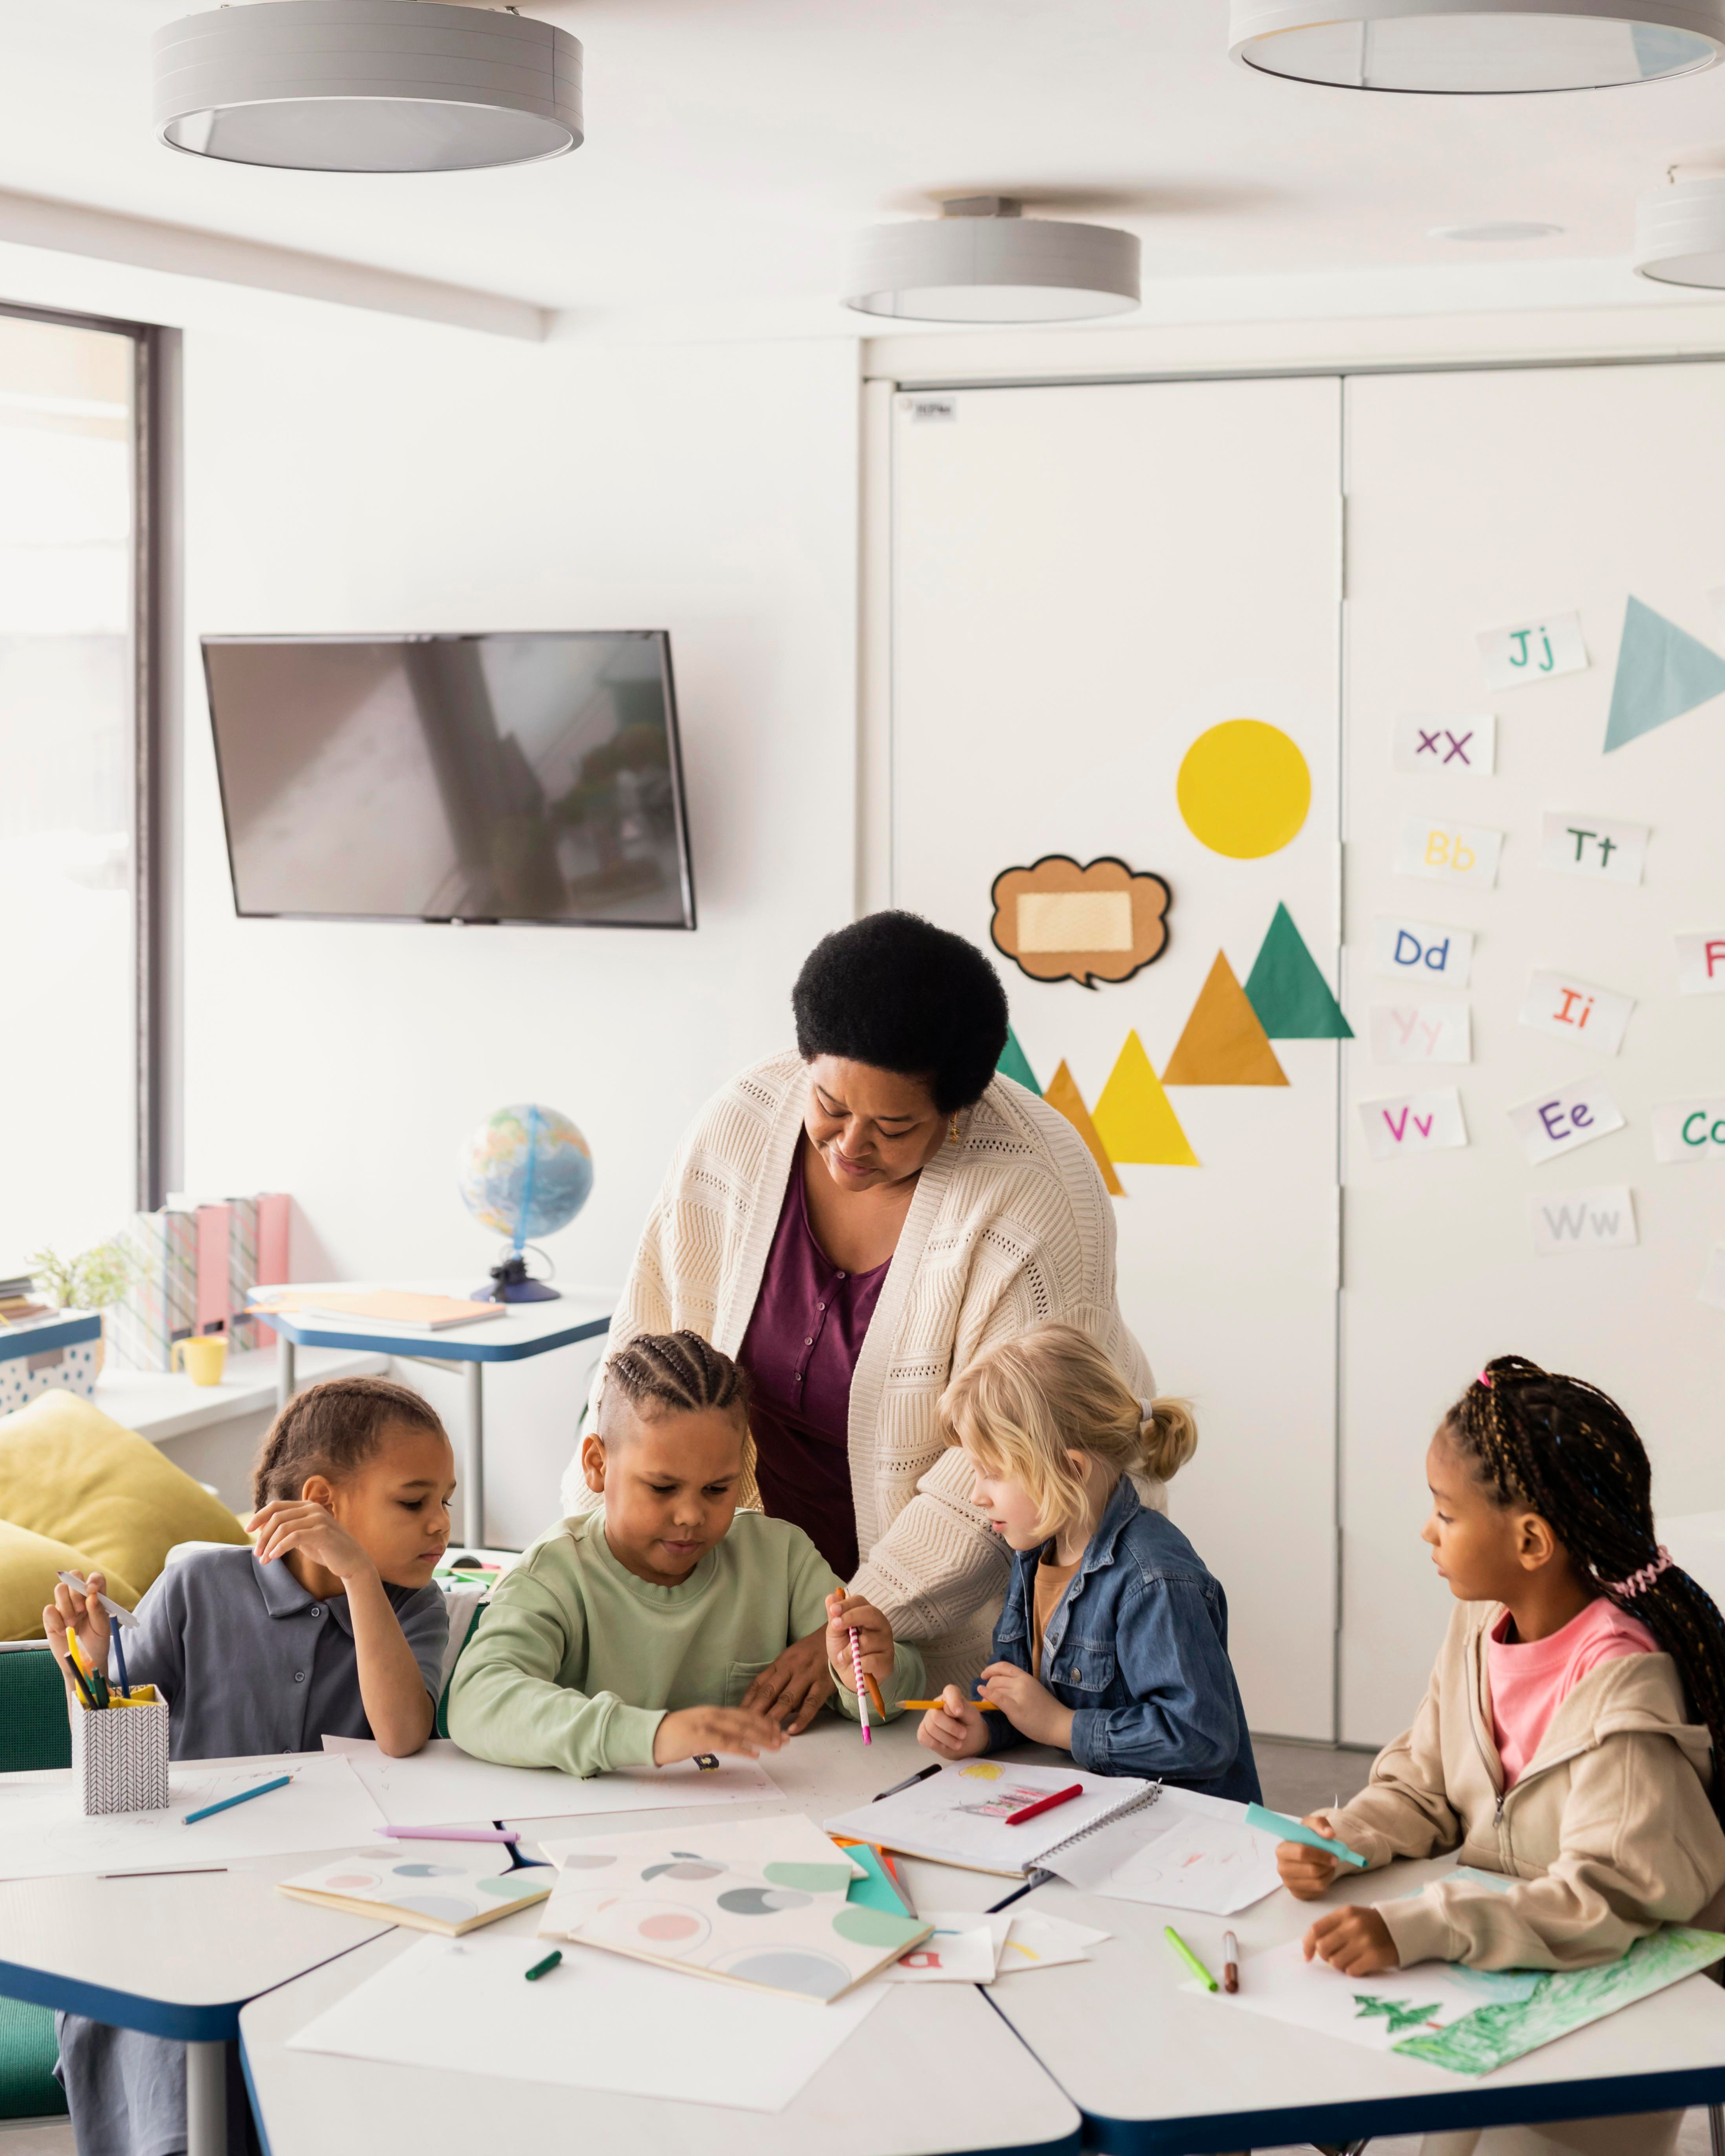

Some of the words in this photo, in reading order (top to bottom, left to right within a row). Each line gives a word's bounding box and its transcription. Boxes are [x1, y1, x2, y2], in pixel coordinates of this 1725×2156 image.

[1509, 626, 1554, 672] Jj
[1424, 830, 1476, 871] Bb
[1567, 827, 1617, 868] Tt
[1393, 930, 1450, 972] Dd
[1552, 987, 1594, 1029] Ii
[1383, 1106, 1433, 1142] Vv
[1538, 1101, 1594, 1140] Ee
[1542, 1202, 1620, 1239] Ww
